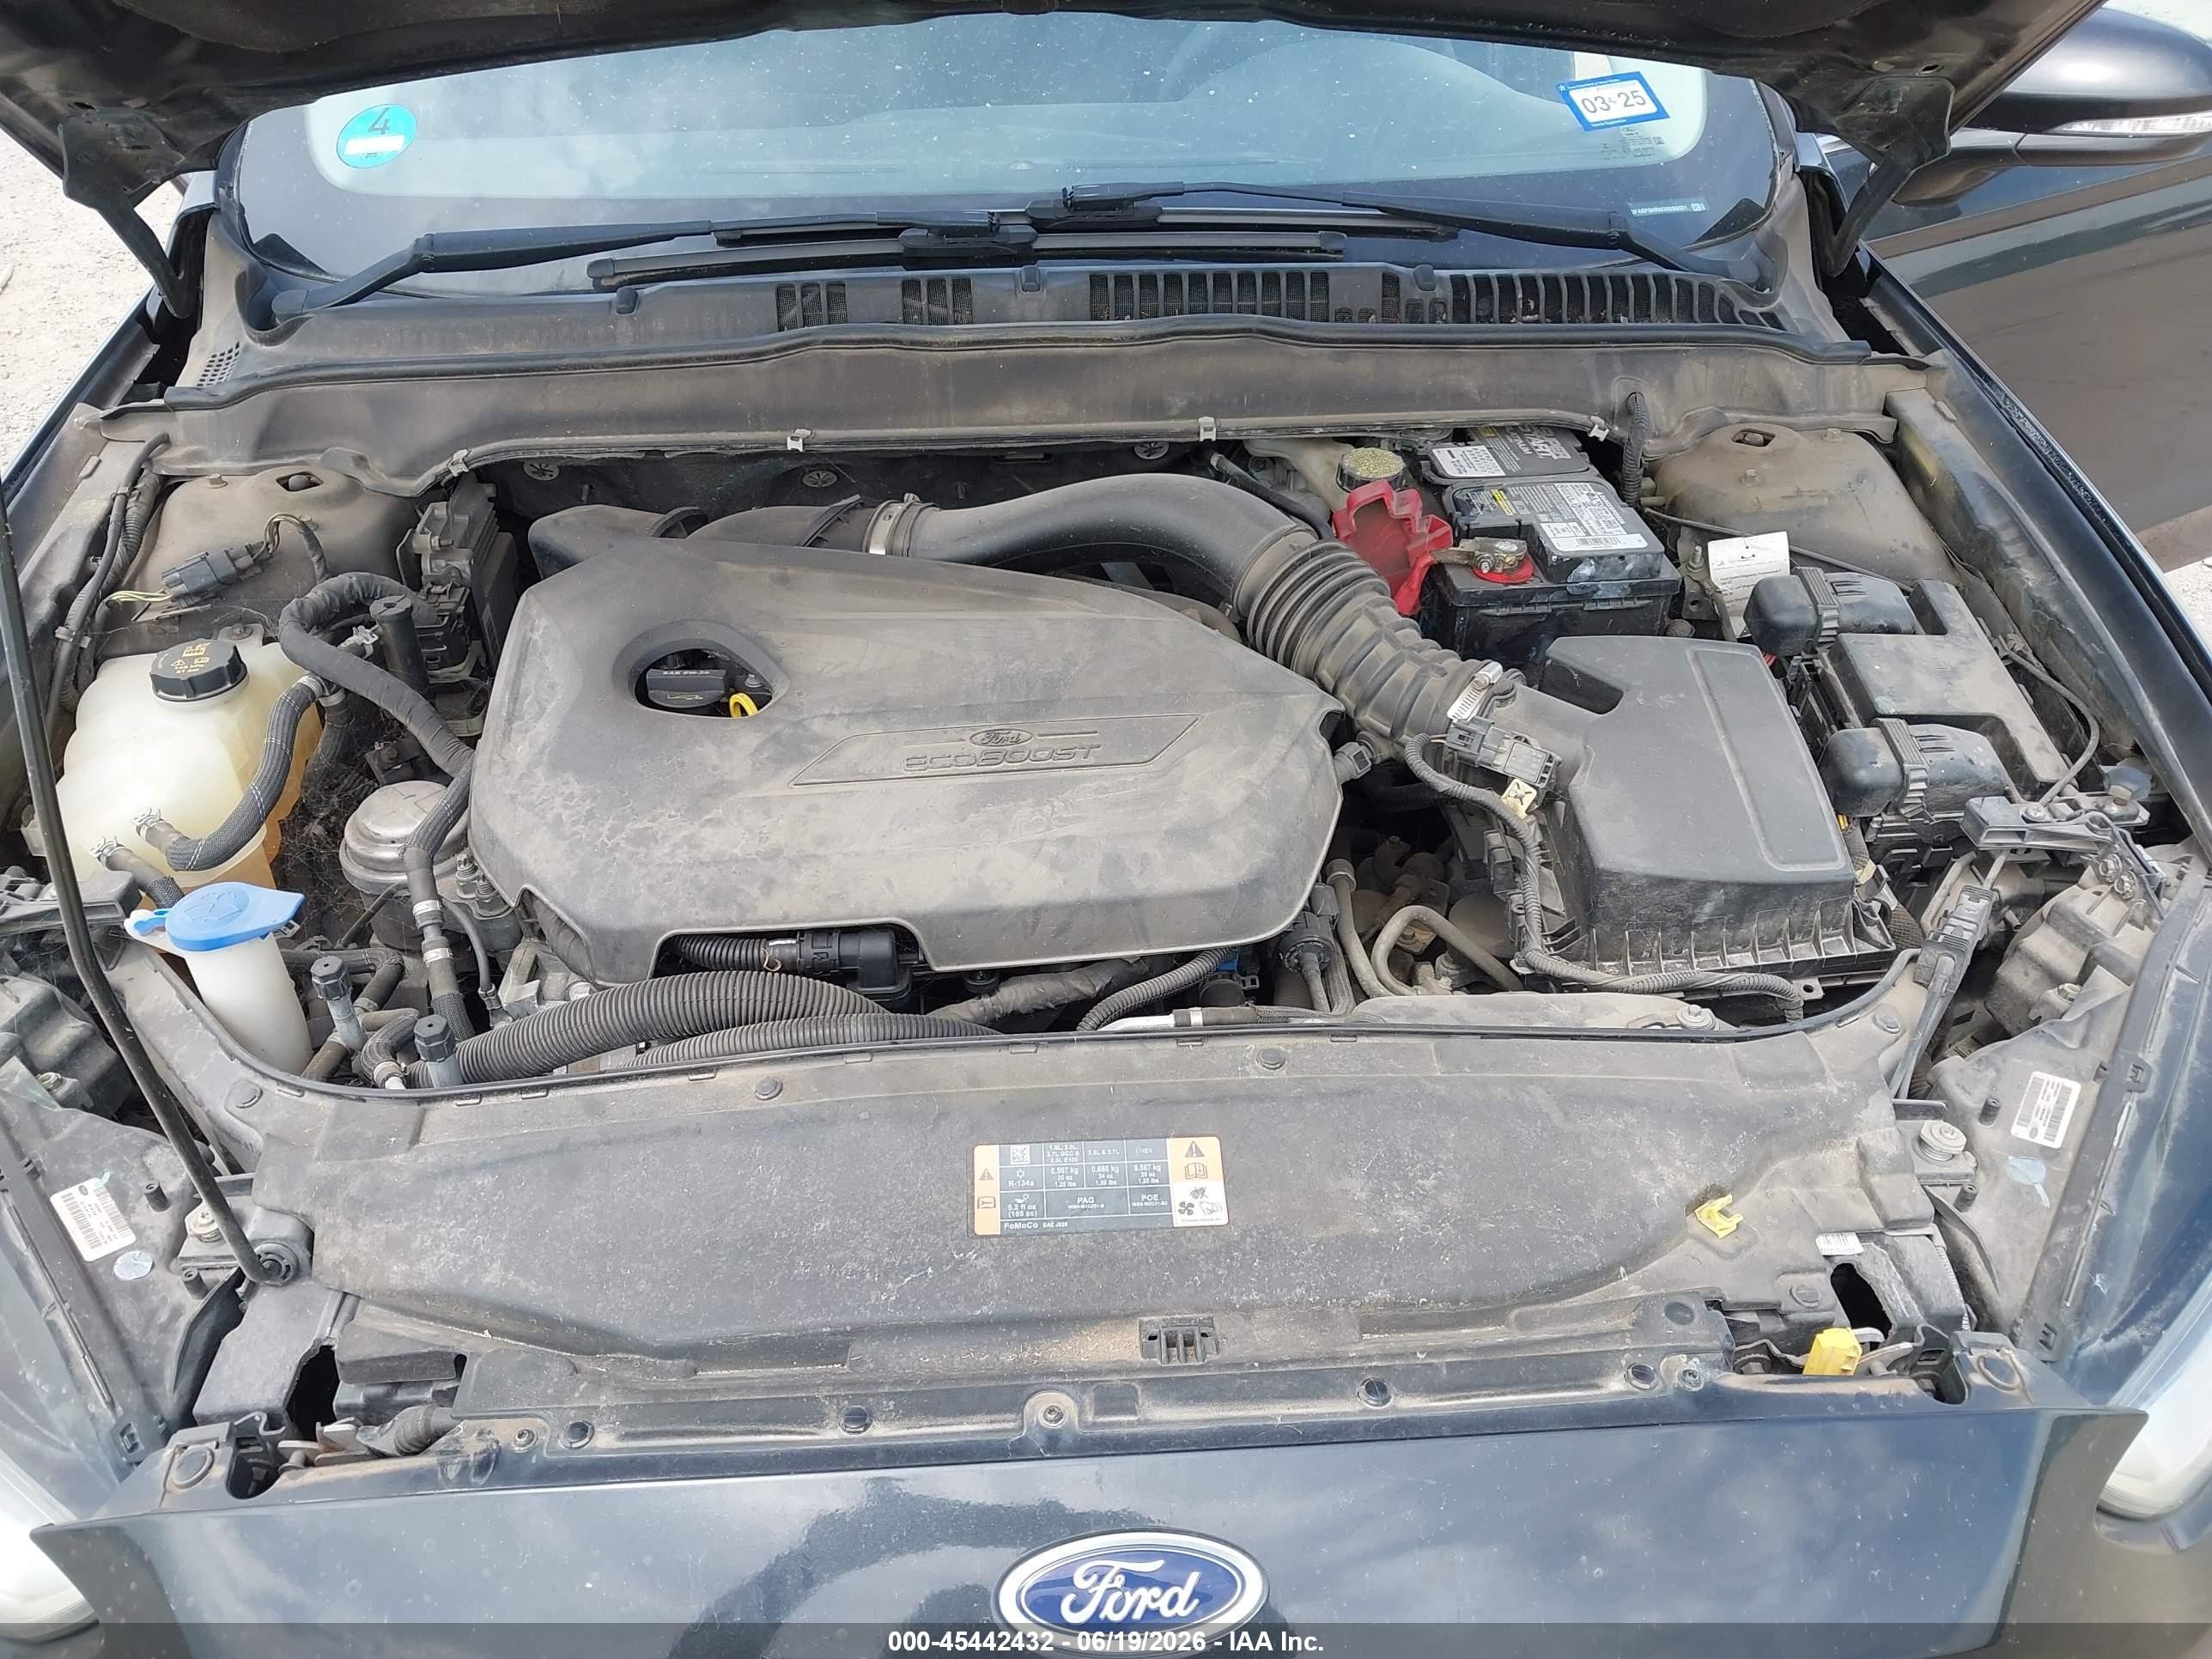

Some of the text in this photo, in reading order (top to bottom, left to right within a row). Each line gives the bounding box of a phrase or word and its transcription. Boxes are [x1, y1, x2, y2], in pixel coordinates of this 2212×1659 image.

[1581, 89, 1647, 113] 03 25
[368, 106, 392, 135] 4
[981, 731, 1021, 745] Ford
[1070, 1166, 1079, 1176] kg
[1110, 1164, 1120, 1174] kg
[1152, 1163, 1162, 1172] kg
[1004, 1221, 1039, 1230] FoMoCo
[1060, 1559, 1200, 1624] Ford
